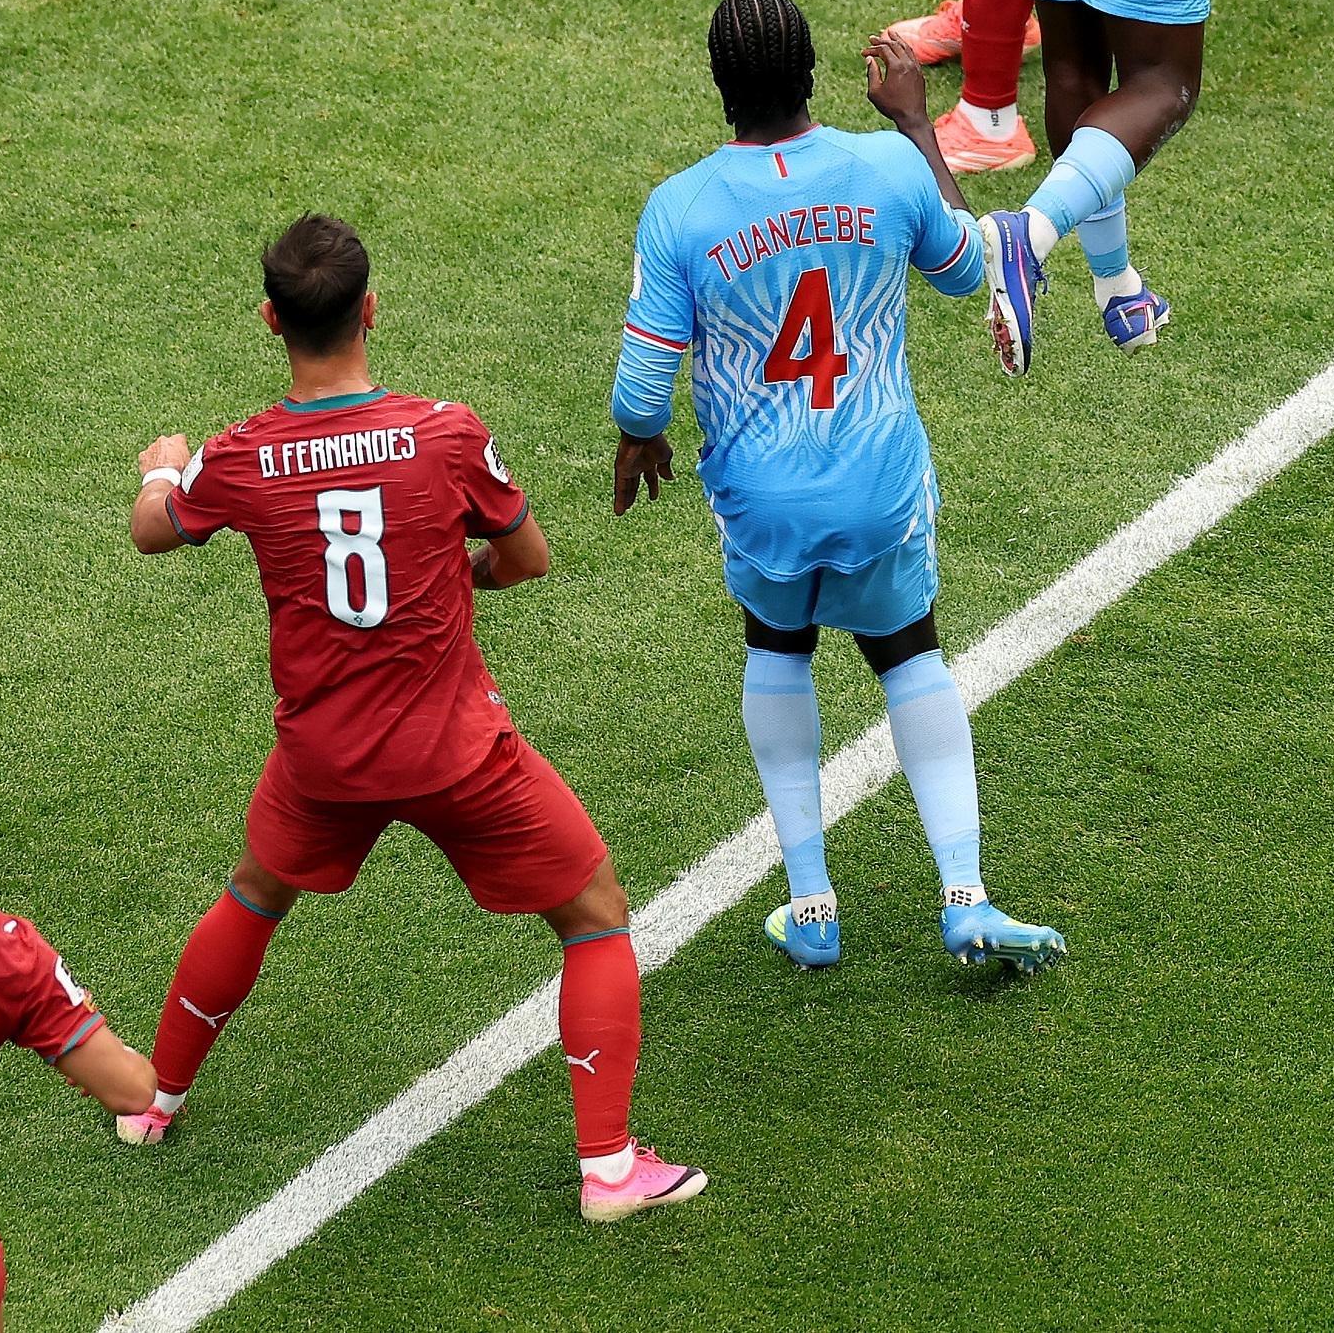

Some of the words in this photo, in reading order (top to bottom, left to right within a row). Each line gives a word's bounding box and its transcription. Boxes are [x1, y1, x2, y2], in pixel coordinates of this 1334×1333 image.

[707, 205, 876, 282] TUANZEBE
[763, 266, 849, 412] 4
[257, 425, 417, 479] B.FERNANDES
[316, 484, 389, 629] 8
